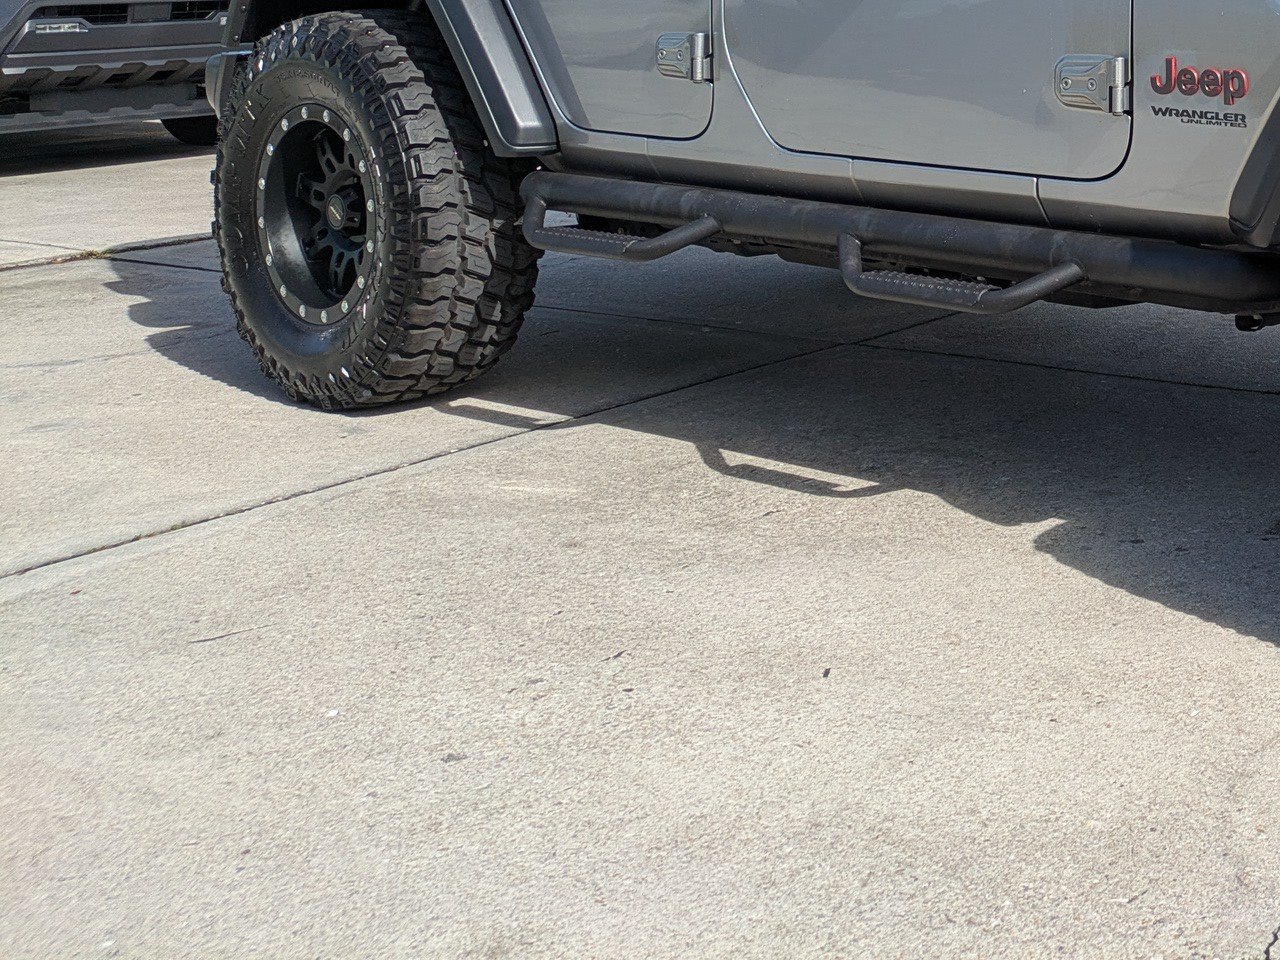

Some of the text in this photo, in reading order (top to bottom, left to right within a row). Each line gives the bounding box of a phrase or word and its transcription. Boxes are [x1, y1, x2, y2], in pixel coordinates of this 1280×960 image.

[1150, 56, 1249, 106] Jeep
[1150, 105, 1247, 123] WRANGLER
[1180, 118, 1247, 129] UNLIMITED
